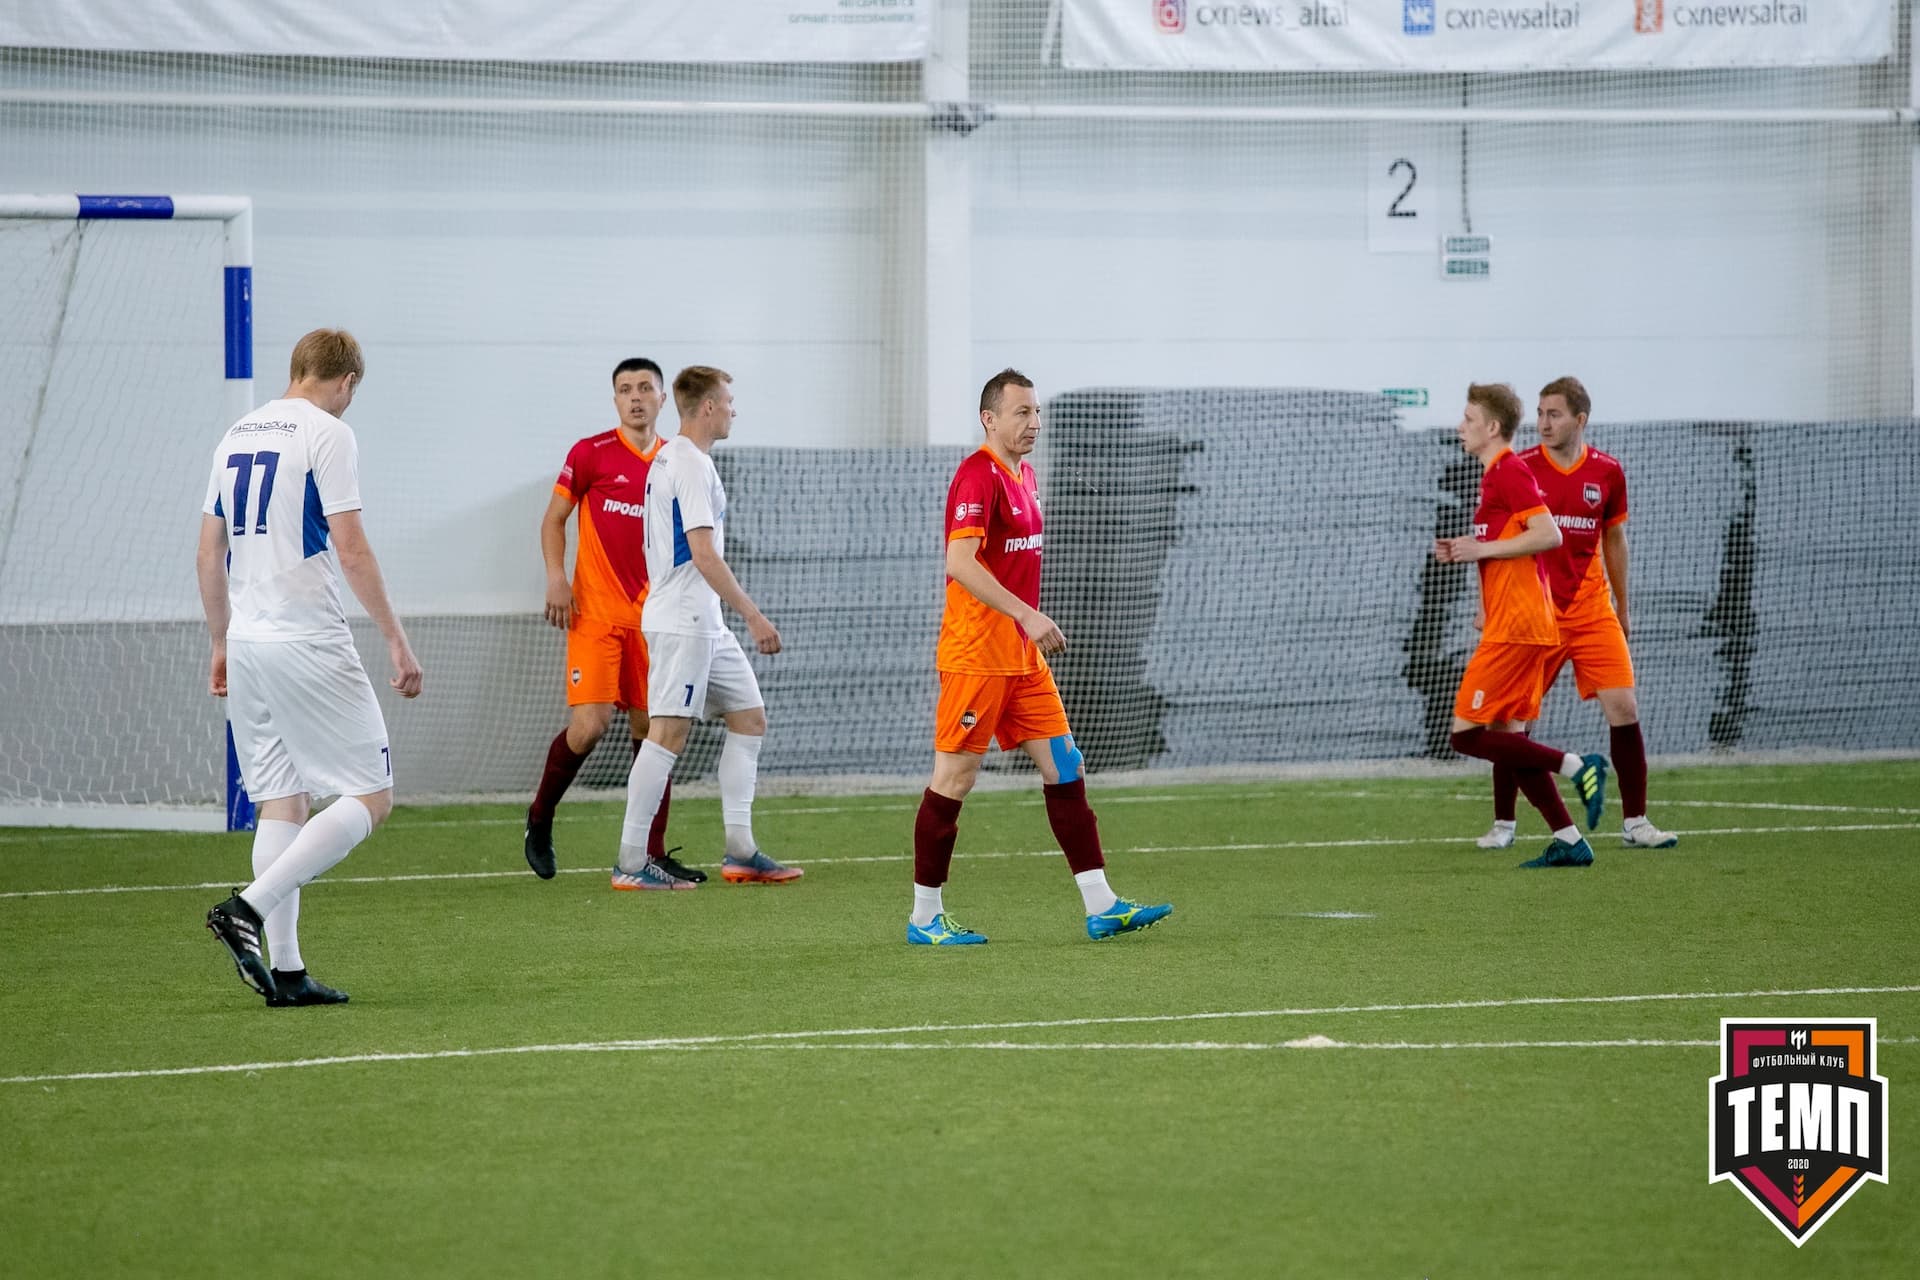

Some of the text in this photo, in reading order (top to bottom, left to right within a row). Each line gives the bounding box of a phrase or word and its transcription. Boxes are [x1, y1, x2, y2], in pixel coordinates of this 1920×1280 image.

[1196, 0, 1350, 31] cxnews_altai
[1445, 1, 1580, 30] cxnewsaltai
[1673, 0, 1808, 27] cxnewsaltai
[1387, 158, 1417, 217] 2
